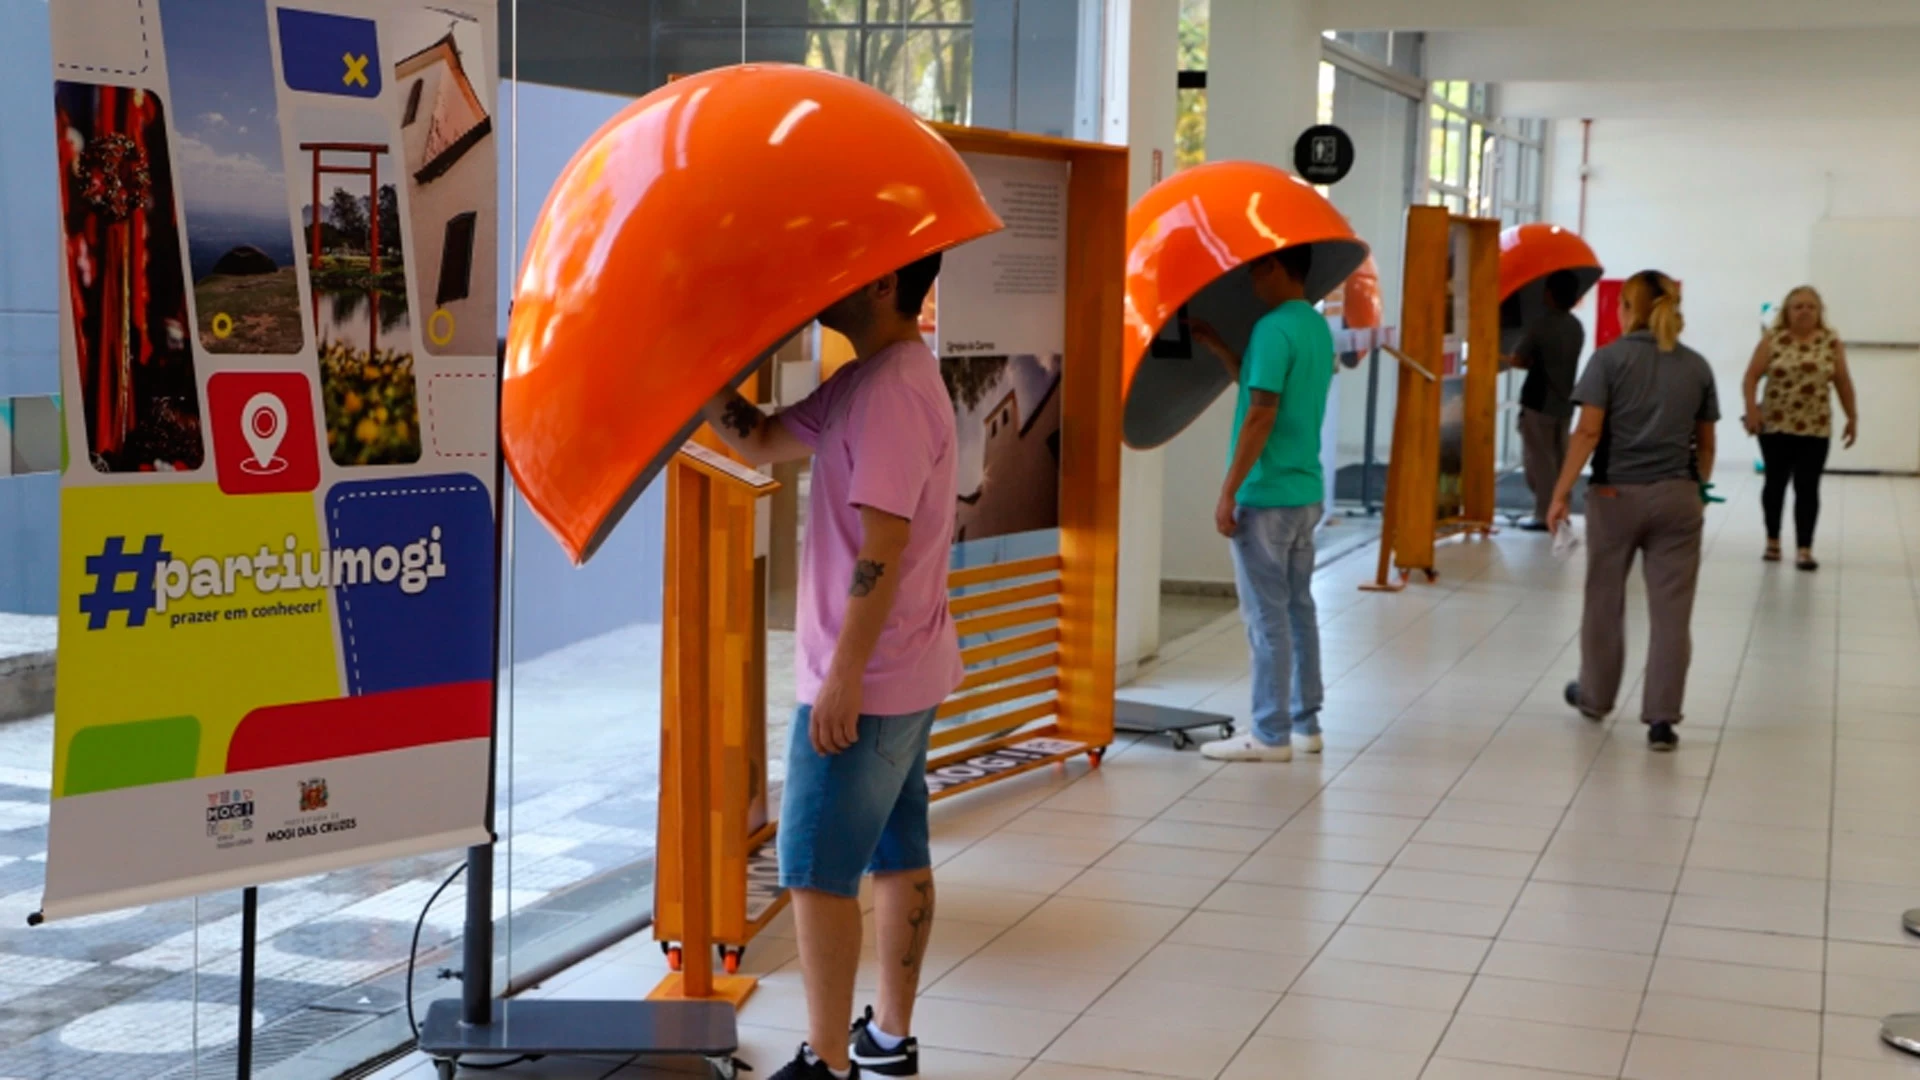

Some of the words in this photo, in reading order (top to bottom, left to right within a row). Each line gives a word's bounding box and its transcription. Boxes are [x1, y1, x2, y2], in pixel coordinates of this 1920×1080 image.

[79, 525, 446, 631] #partiumogi
[170, 610, 219, 628] prazer
[224, 607, 248, 620] em
[251, 599, 322, 618] conhecer!
[266, 828, 296, 843] MOGI
[298, 824, 318, 837] DAS
[320, 818, 357, 834] CRUZES
